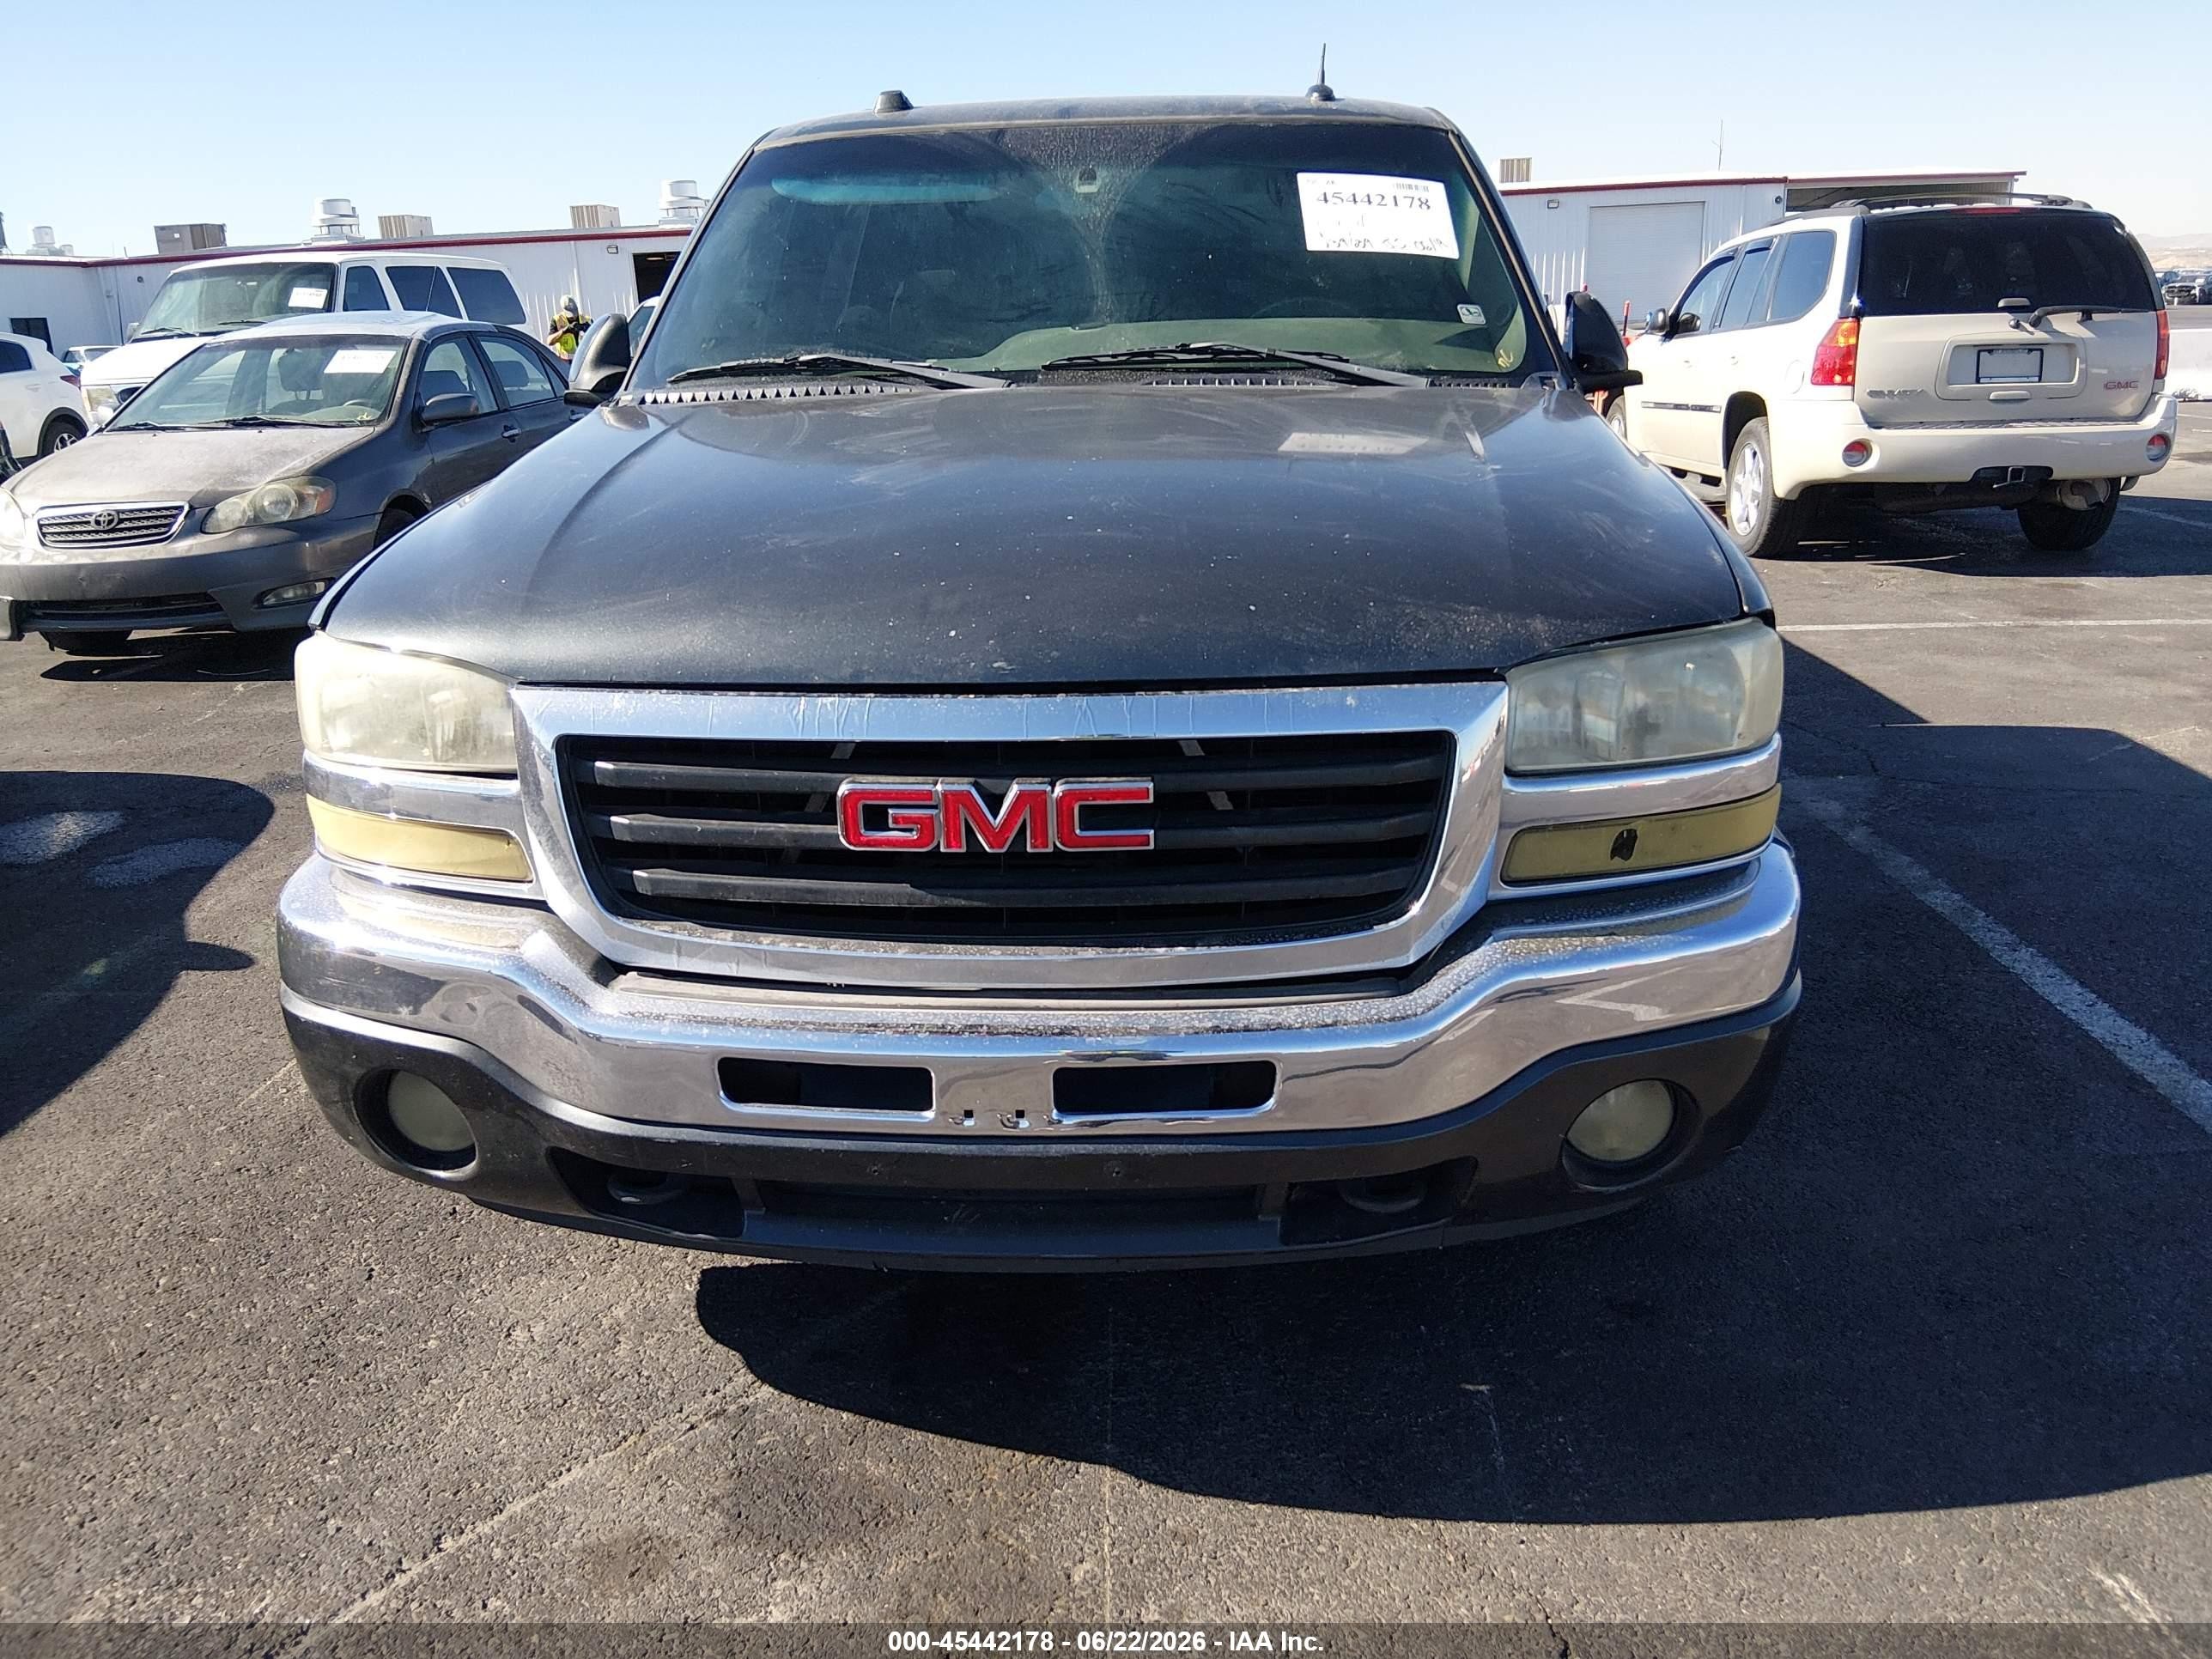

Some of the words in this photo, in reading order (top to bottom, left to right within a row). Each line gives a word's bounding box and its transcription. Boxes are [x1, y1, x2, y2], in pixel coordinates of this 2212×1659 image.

[1316, 191, 1431, 210] 45442178
[2104, 380, 2140, 390] GMC
[836, 777, 1154, 853] GMC
